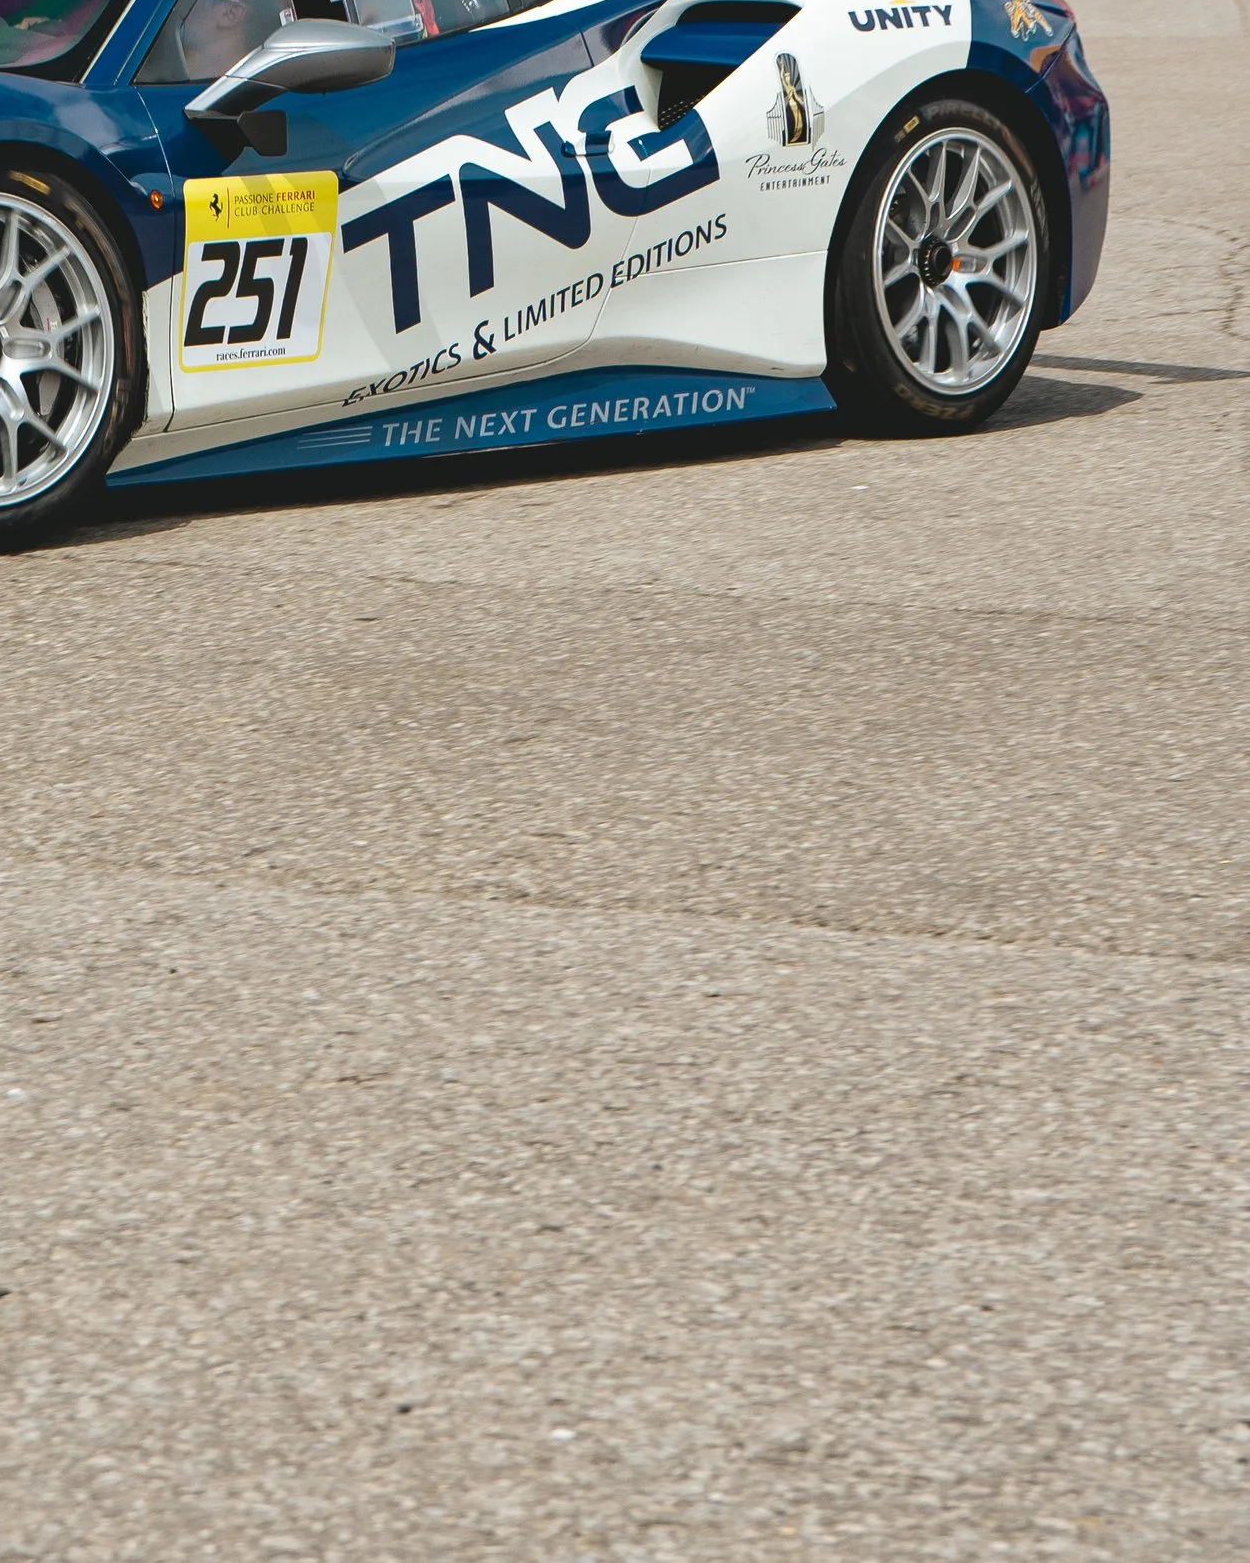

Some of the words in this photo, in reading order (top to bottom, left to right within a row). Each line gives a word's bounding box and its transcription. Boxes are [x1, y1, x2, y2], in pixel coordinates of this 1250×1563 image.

[847, 4, 953, 32] UNITY
[745, 153, 805, 179] Princess
[804, 147, 848, 175] Gates
[234, 193, 274, 206] PASSIONE
[276, 189, 316, 202] FERRARI
[759, 175, 831, 192] ENTERTAINMENT
[234, 205, 258, 218] CLUB
[261, 202, 316, 216] CHALLENGE
[341, 84, 721, 334] TNG
[183, 237, 308, 347] 251
[342, 341, 463, 408] EXOTICS
[471, 318, 498, 361] &
[503, 271, 604, 343] LIMITED
[610, 213, 728, 289] EDITIONS
[215, 346, 287, 362] races.ferrari.com
[382, 418, 443, 448] THE
[454, 408, 538, 440] NEXT
